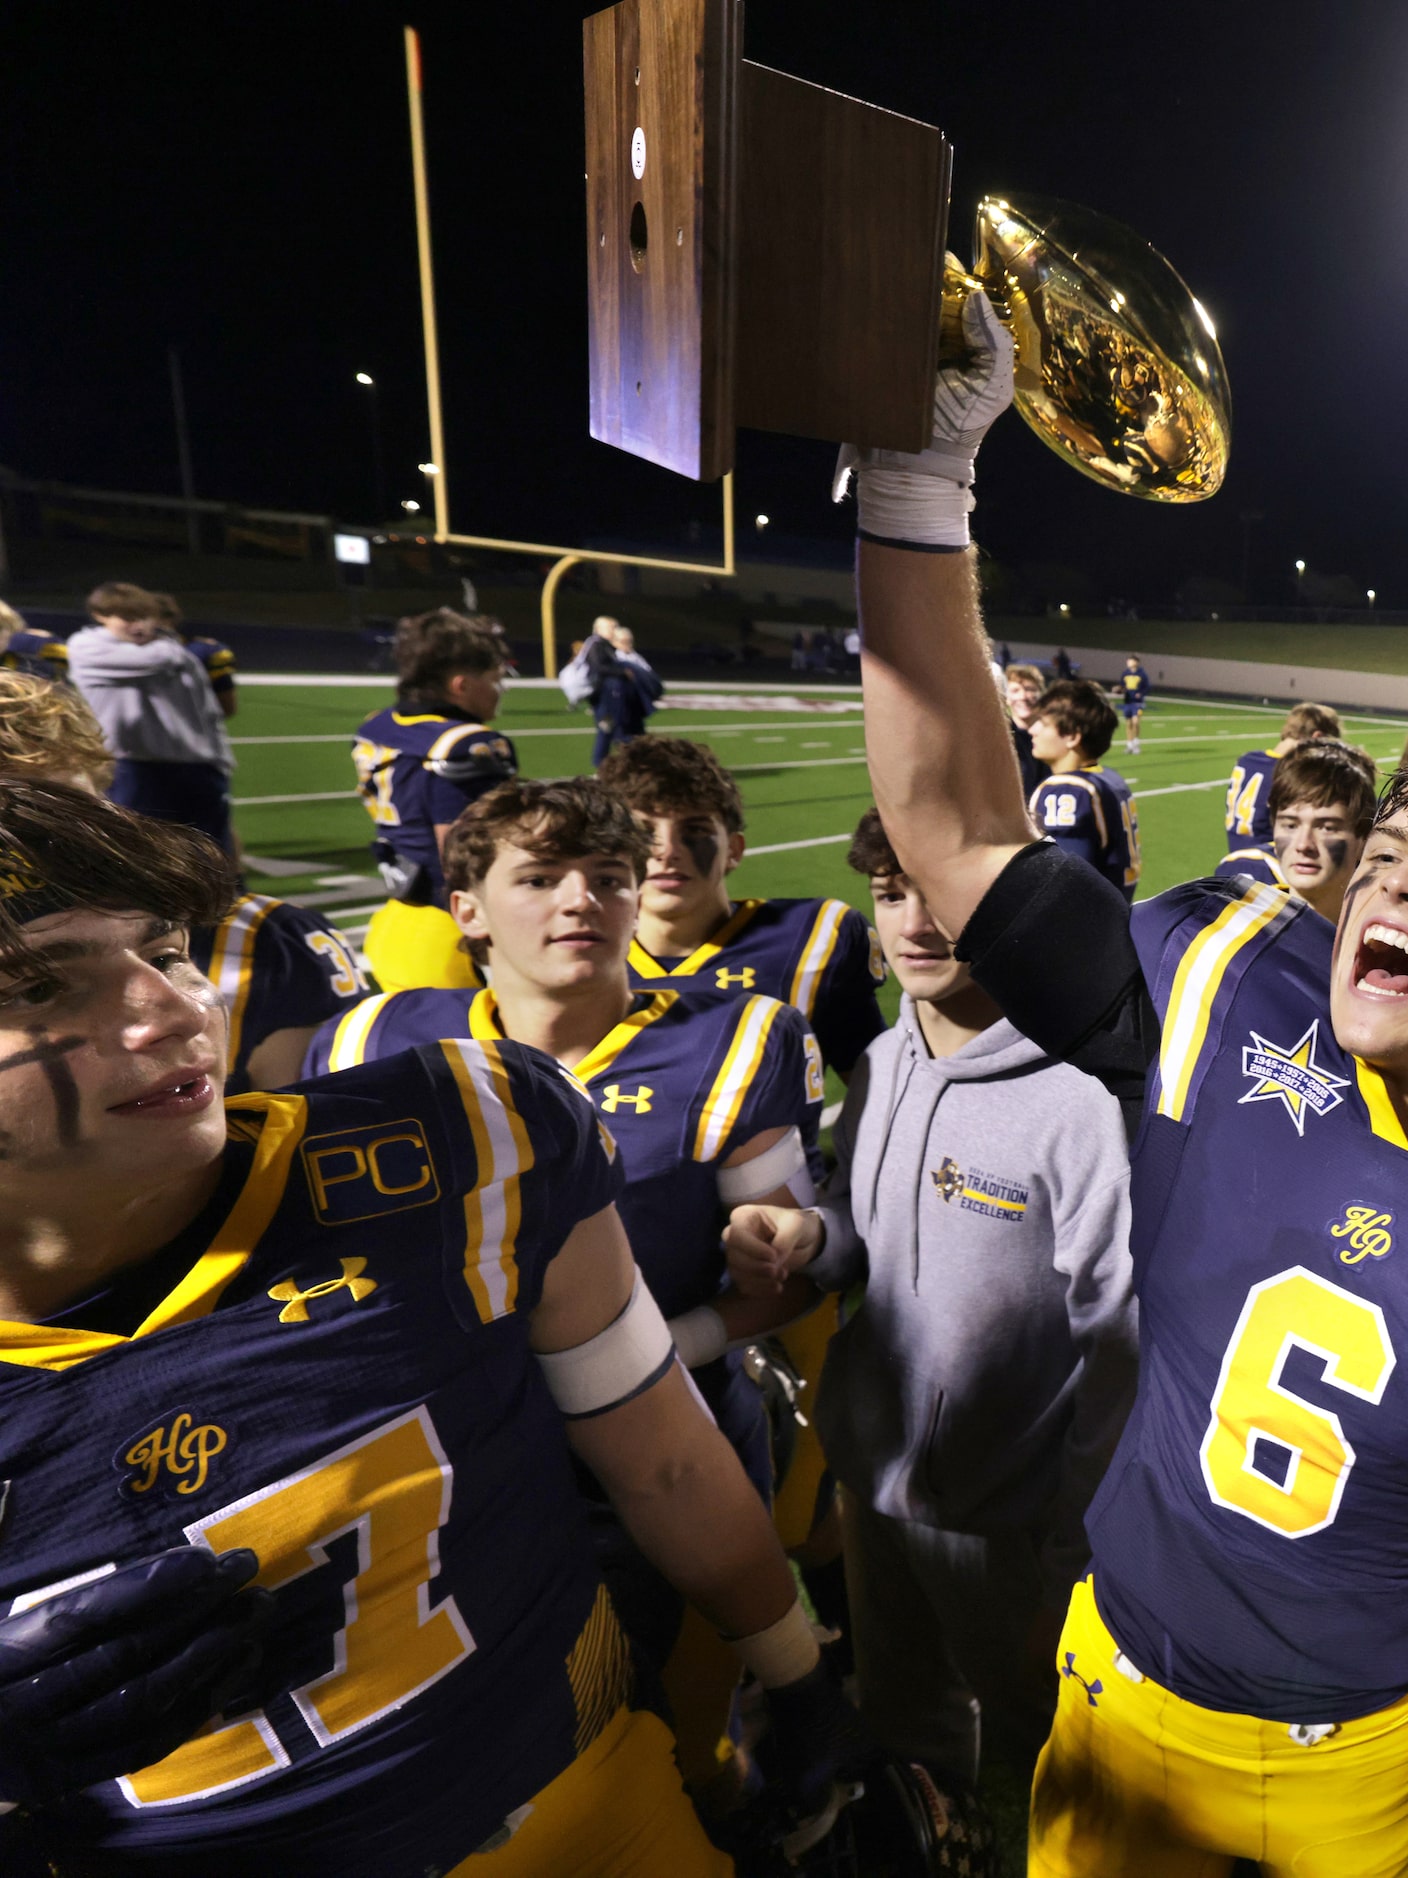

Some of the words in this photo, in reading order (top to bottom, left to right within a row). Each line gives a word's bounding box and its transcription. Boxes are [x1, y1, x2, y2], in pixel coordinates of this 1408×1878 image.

[1043, 794, 1077, 827] 12
[304, 927, 371, 998] 3
[1249, 1062, 1274, 1077] 2016
[1278, 1073, 1300, 1089] 2017
[1253, 1054, 1279, 1070] 1945
[1282, 1065, 1305, 1081] 1957
[307, 1133, 431, 1211] PC
[968, 1174, 1028, 1204] TRADITION
[959, 1196, 1025, 1222] EXCELLENCE
[1330, 1206, 1393, 1265] HP
[1199, 1264, 1398, 1540] 6
[125, 1412, 228, 1495] HP
